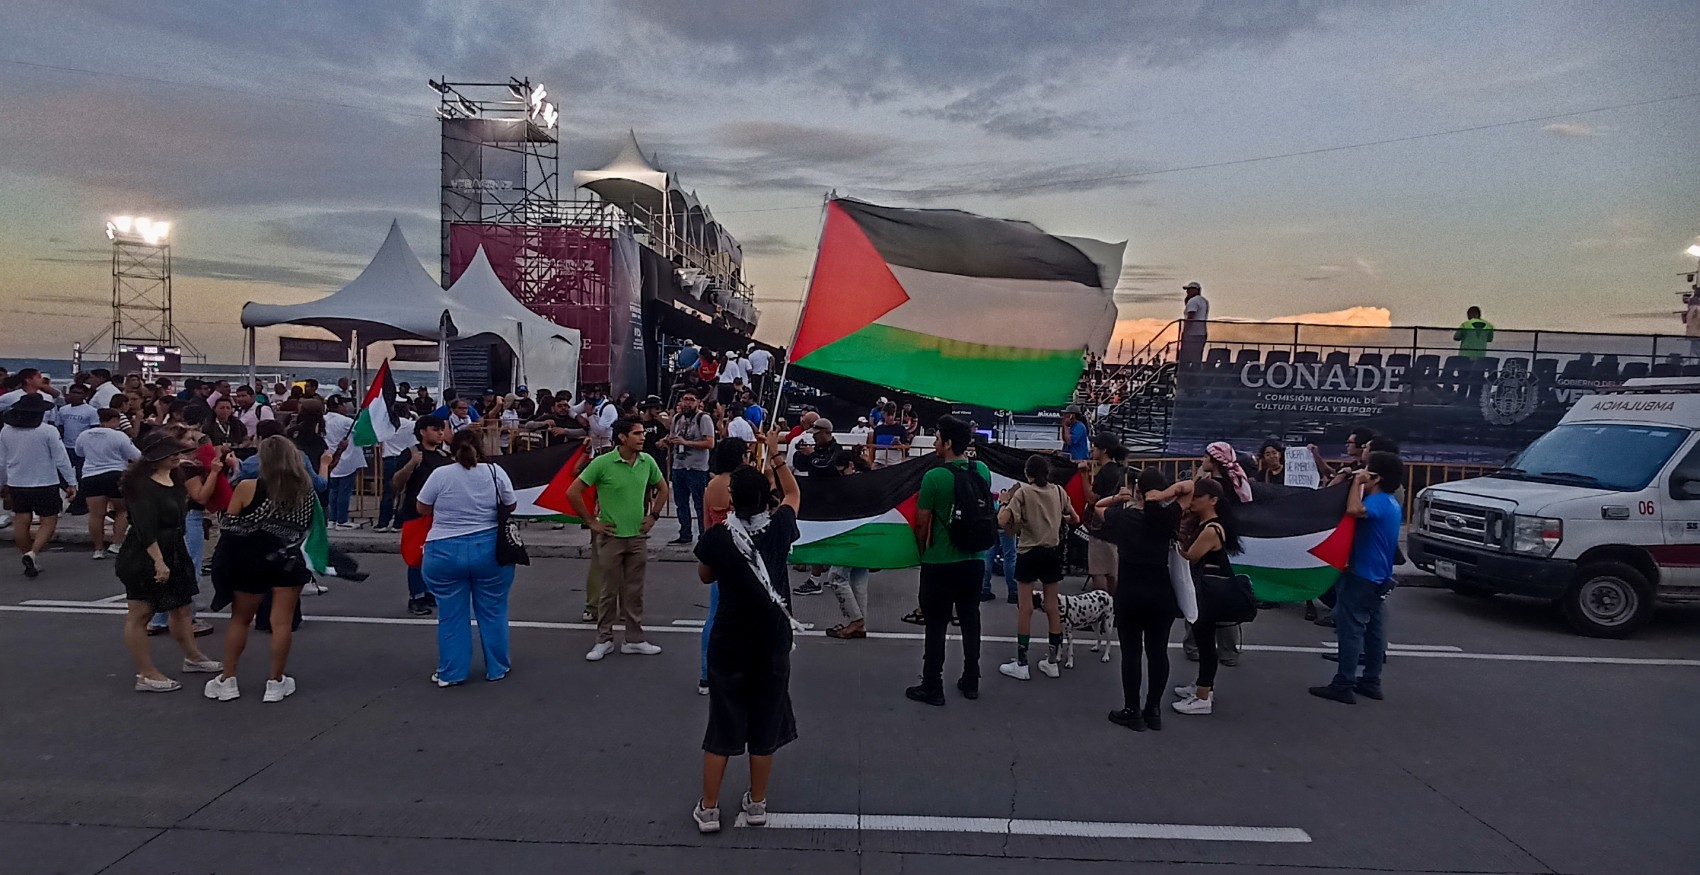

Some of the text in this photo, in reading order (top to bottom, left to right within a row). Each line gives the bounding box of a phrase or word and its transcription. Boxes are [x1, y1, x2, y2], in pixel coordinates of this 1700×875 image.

[1240, 361, 1405, 393] CONADE
[1557, 379, 1601, 387] GOBIERNO
[1264, 393, 1377, 404] COMISIÓN NACIONAL DE
[1254, 402, 1384, 414] CULTURA FÍSICA Y DEPORTE
[1638, 500, 1655, 515] 06
